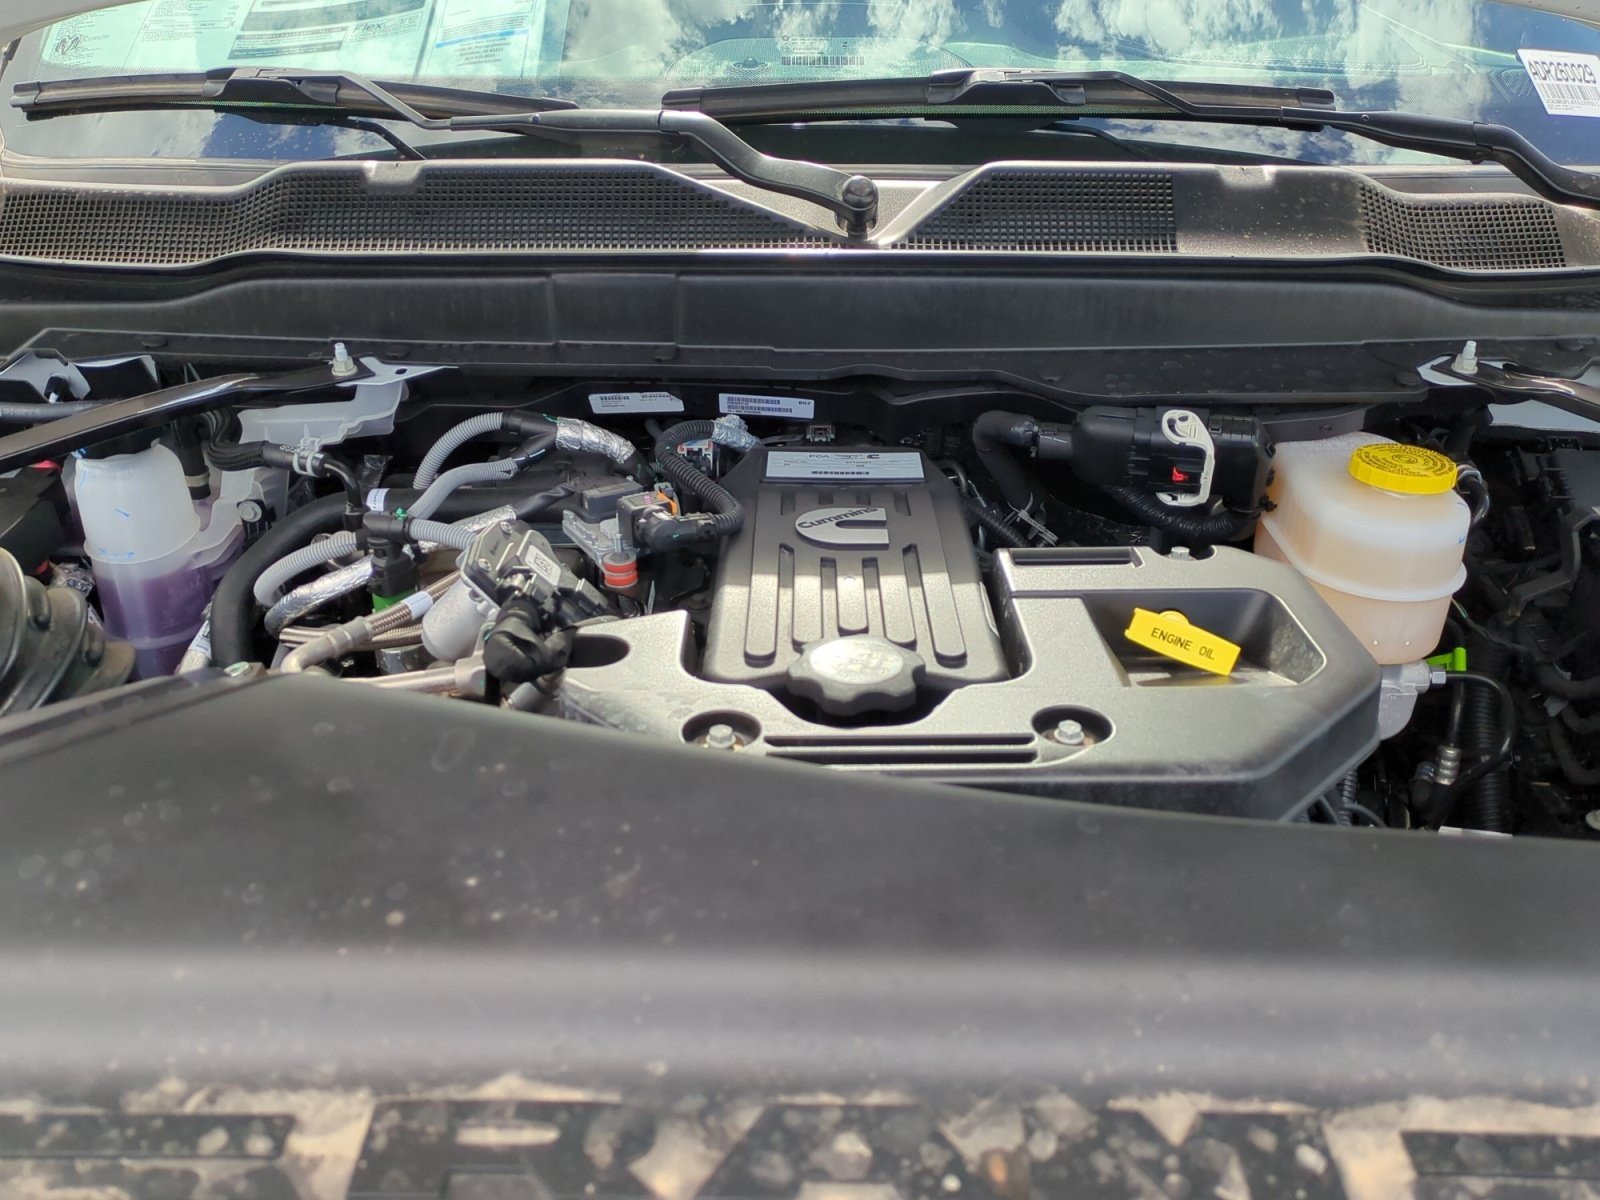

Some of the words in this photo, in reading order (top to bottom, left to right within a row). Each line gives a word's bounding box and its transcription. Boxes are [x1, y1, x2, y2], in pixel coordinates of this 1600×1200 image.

[1528, 61, 1597, 84] ADR260029
[798, 508, 878, 529] Cummins
[1151, 627, 1193, 651] ENGINE
[1198, 645, 1215, 660] OIL
